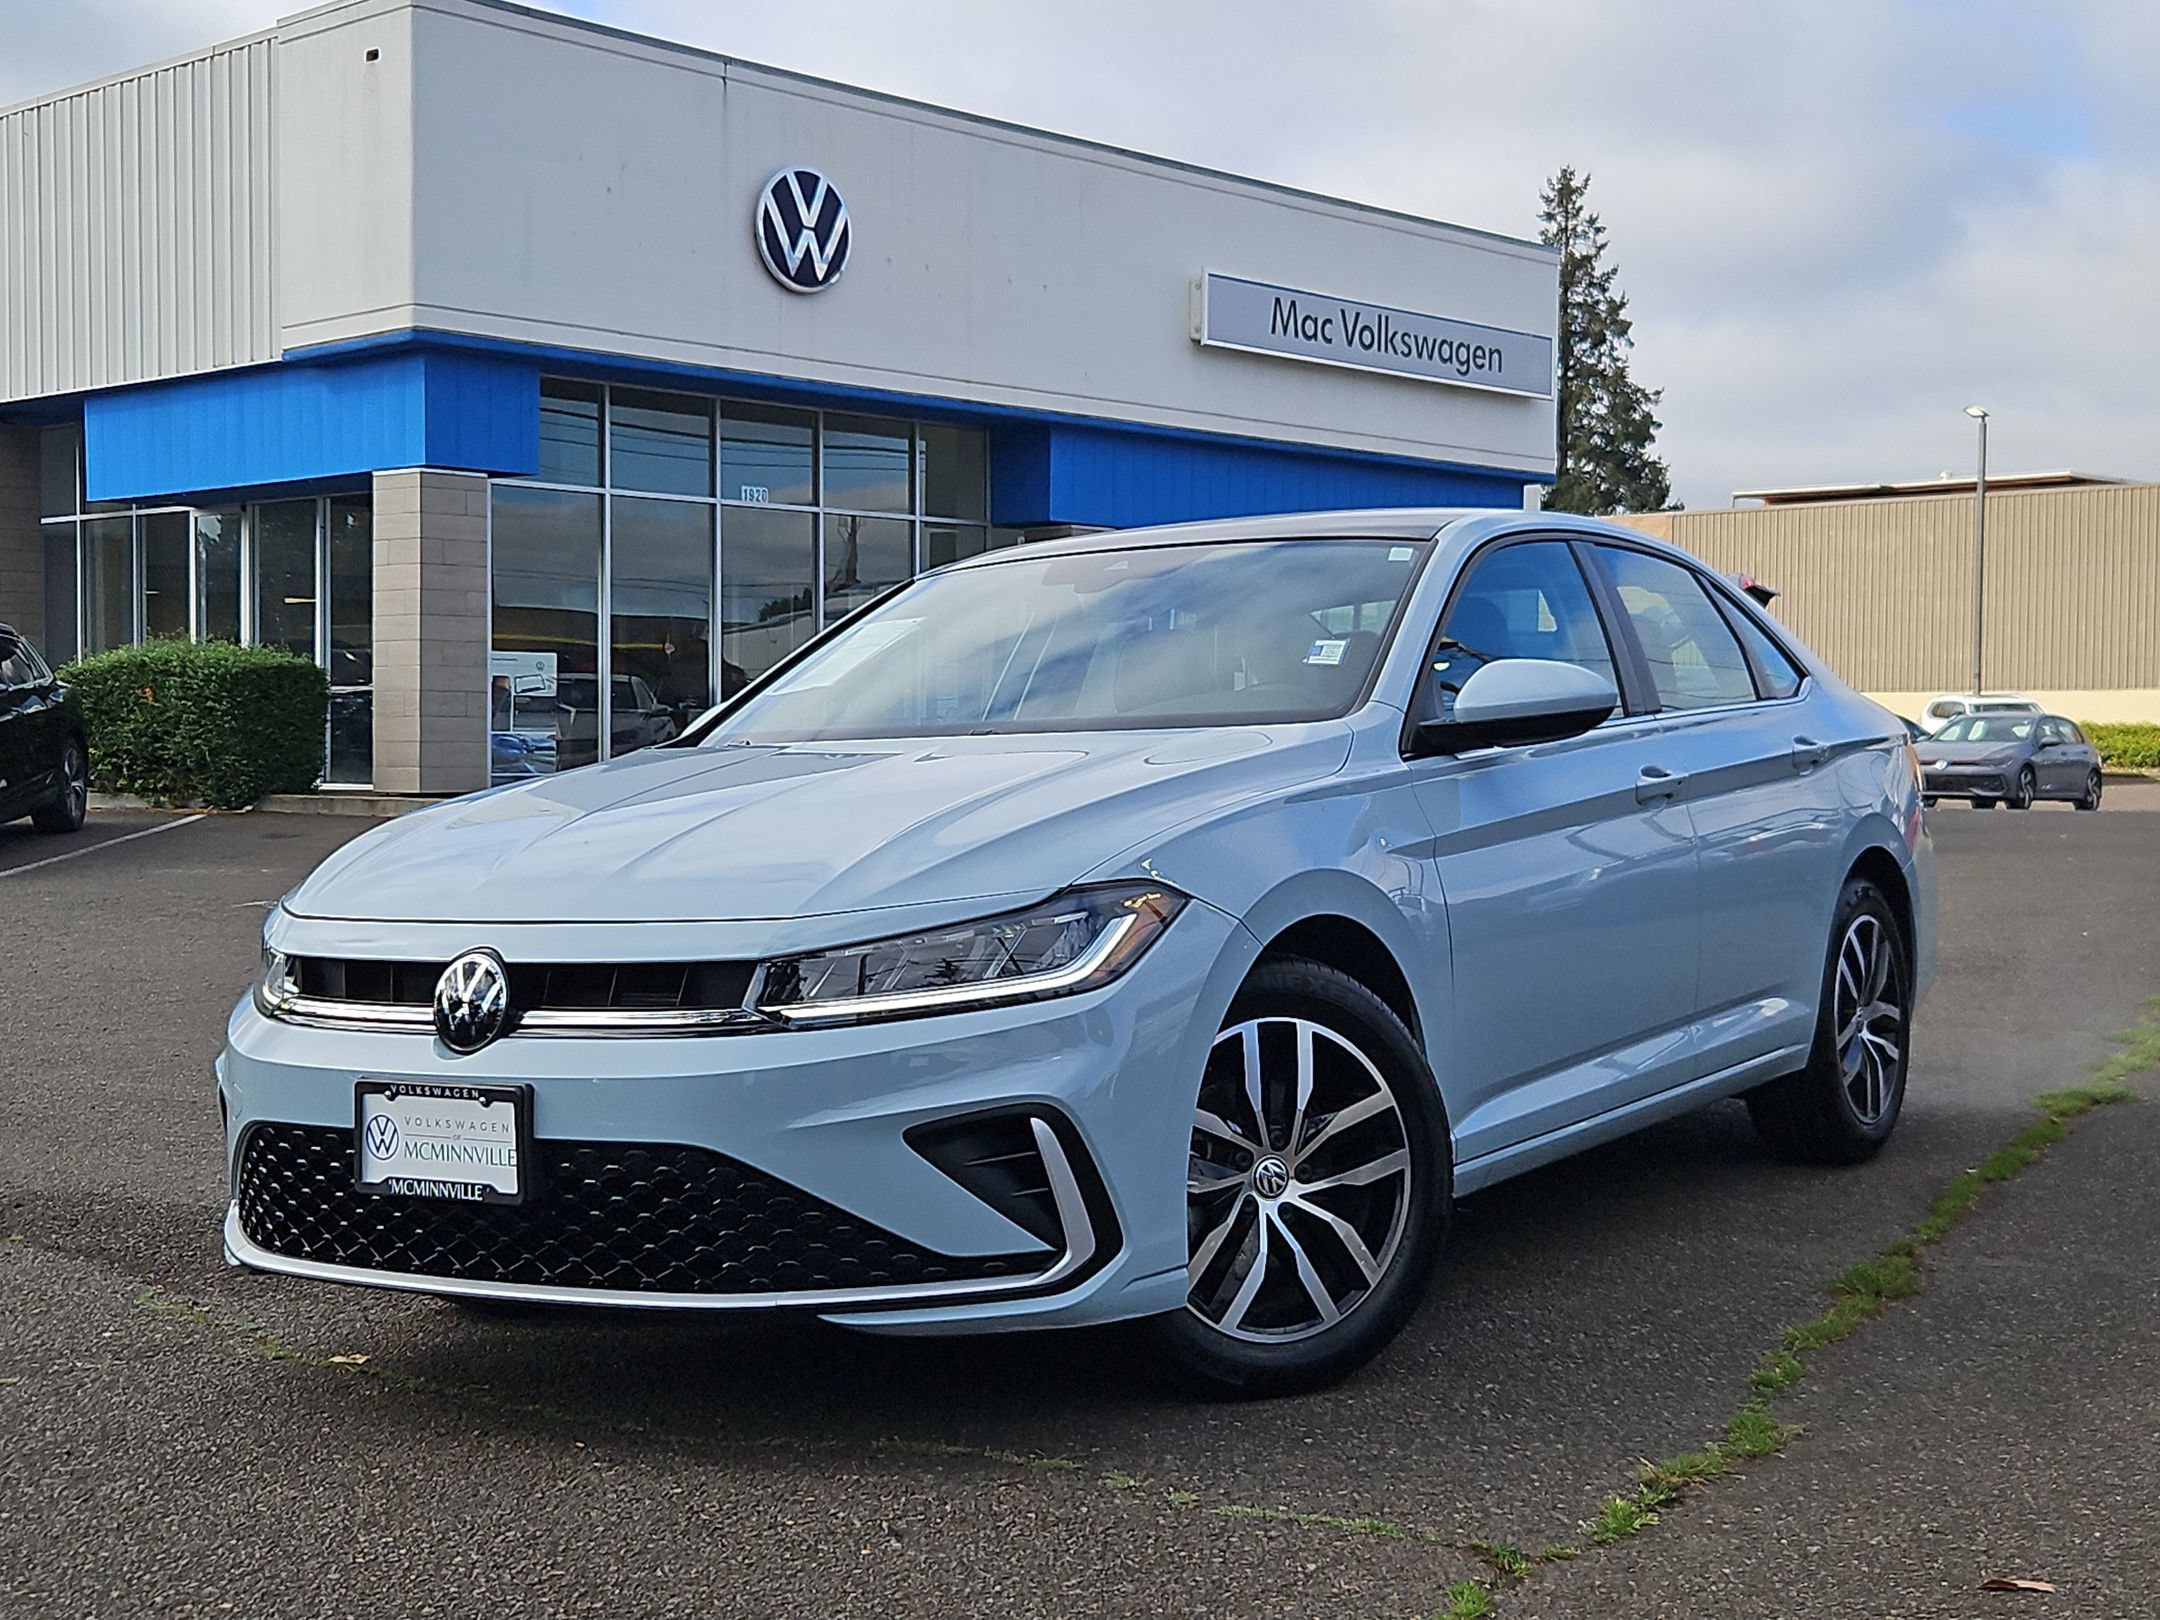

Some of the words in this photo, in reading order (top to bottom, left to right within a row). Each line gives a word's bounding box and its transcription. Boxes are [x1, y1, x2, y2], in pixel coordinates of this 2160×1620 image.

[758, 168, 851, 288] VW
[1270, 296, 1334, 345] Mac
[1339, 308, 1504, 377] Volkswagen
[743, 488, 768, 503] 1920
[390, 1084, 479, 1098] VOLKSWAGEN
[404, 1116, 510, 1133] VOLKSWAGEN
[366, 1114, 399, 1160] VW
[404, 1140, 517, 1167] MCMINNVILLE
[389, 1179, 484, 1201] MCMINNVILLE
